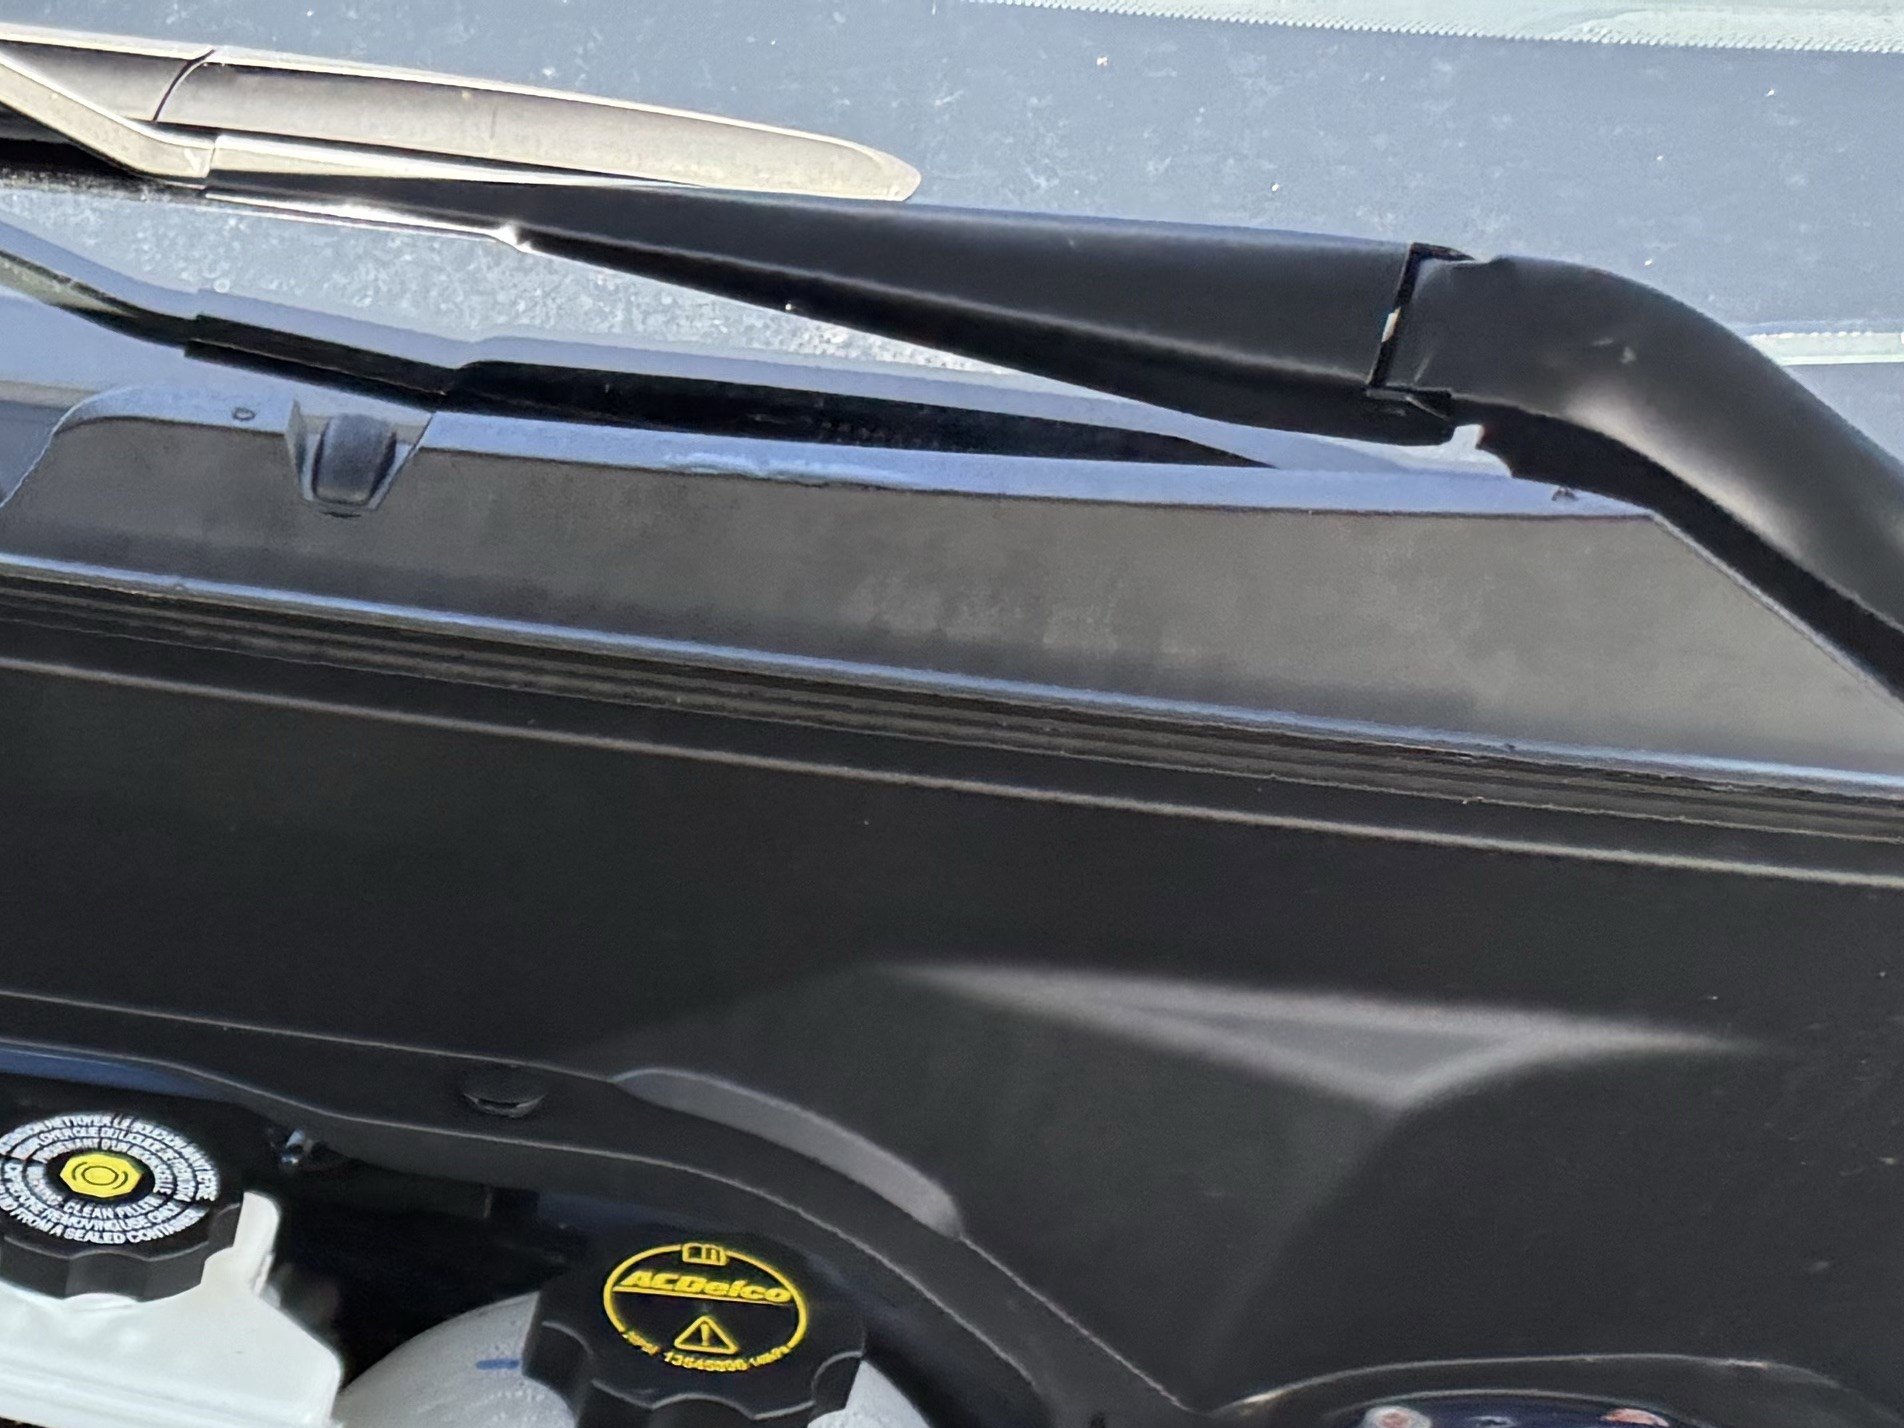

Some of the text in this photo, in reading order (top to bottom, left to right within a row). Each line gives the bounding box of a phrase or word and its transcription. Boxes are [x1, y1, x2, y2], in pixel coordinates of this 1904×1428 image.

[59, 1199, 117, 1221] CLEAN
[61, 1225, 128, 1245] SEALED
[619, 1271, 792, 1303] ACDelco
